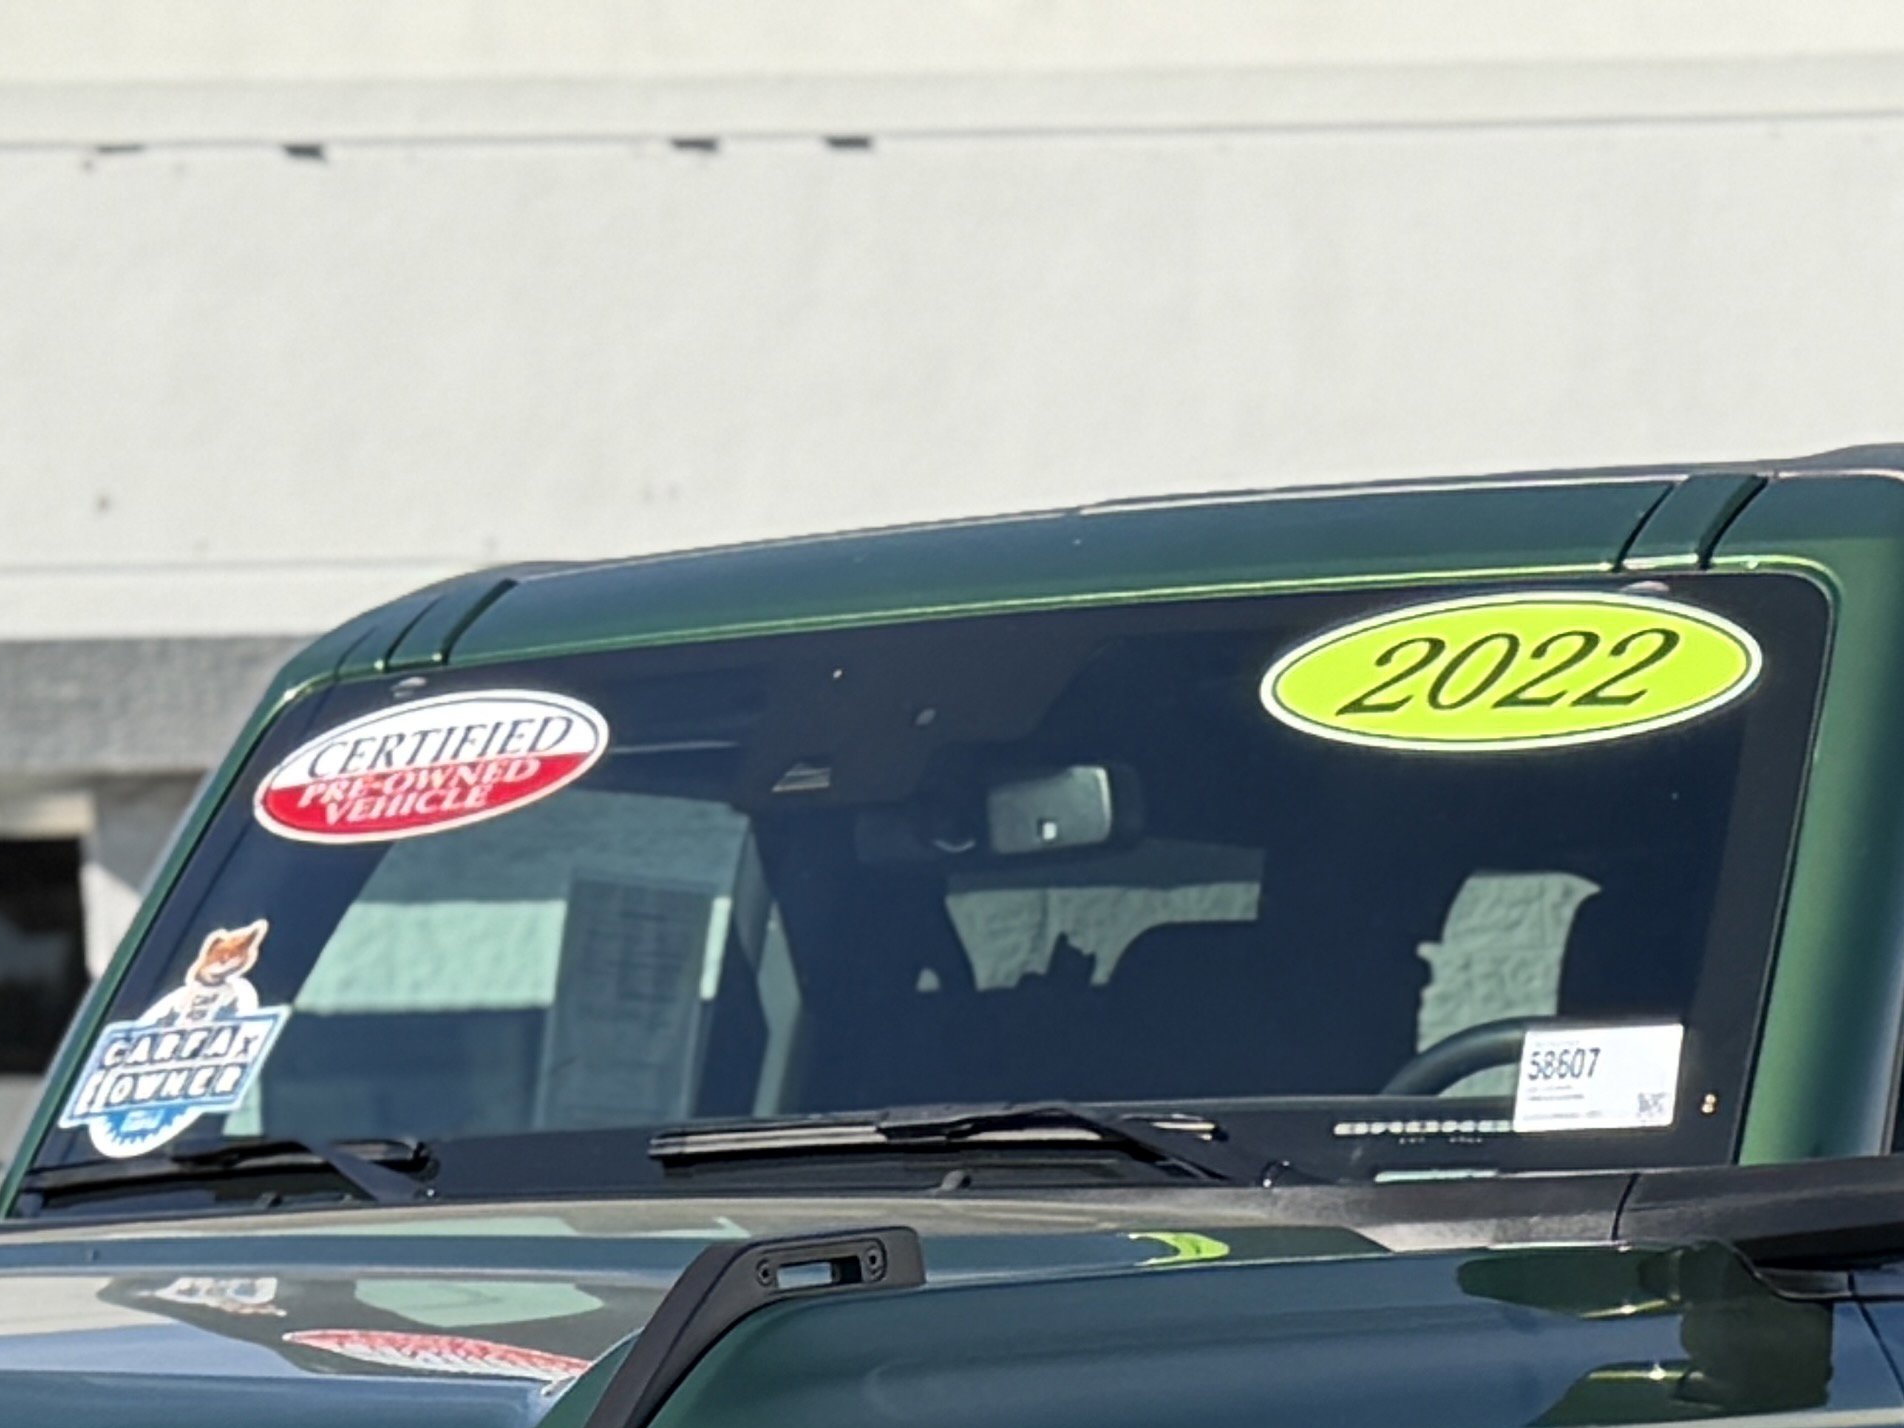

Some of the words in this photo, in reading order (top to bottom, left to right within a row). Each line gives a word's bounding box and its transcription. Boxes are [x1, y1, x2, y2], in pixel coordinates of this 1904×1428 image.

[1335, 627, 1681, 716] 2022
[308, 715, 574, 779] CERTIFIED
[298, 758, 542, 808] PRE-OWNED
[323, 785, 490, 826] VEHICLE
[103, 1024, 260, 1068] CARFAX
[1528, 1047, 1601, 1081] 58607
[107, 1065, 243, 1106] OWNER
